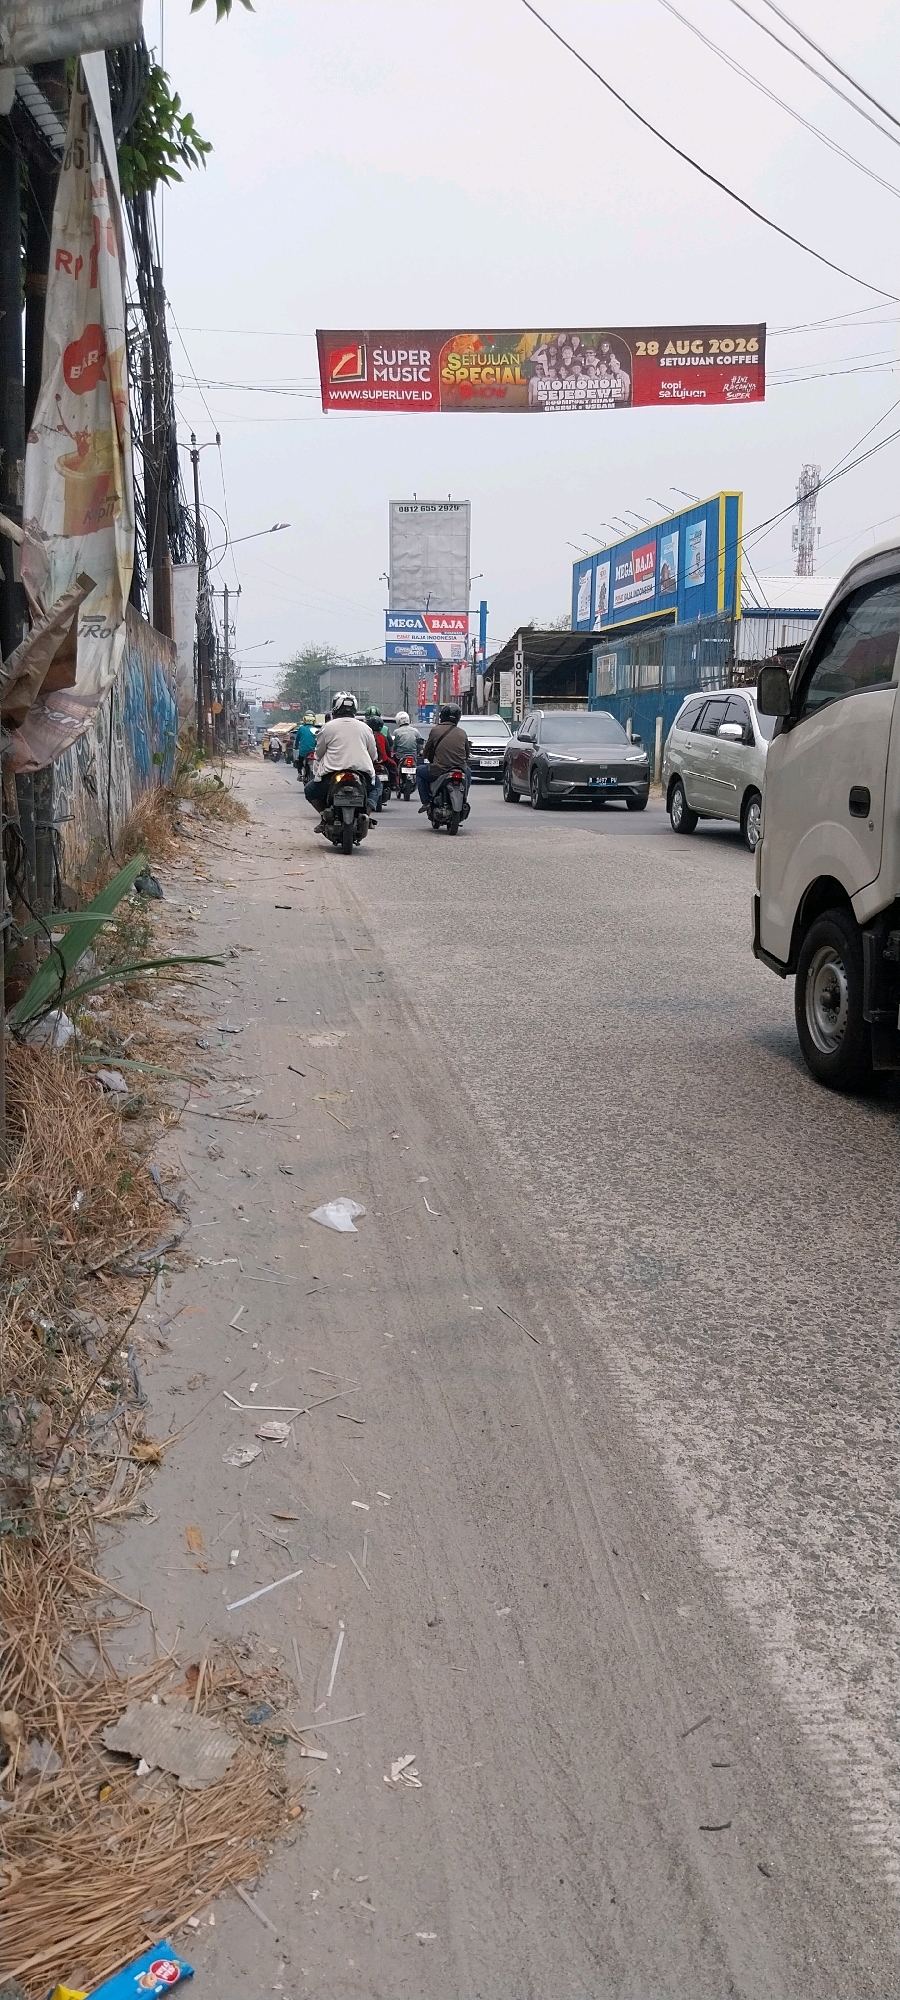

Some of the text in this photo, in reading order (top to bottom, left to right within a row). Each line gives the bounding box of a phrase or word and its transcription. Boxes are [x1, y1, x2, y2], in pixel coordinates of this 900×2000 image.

[635, 337, 759, 356] 28 AUG 2026
[372, 349, 431, 366] SUPER
[447, 352, 520, 371] SETUJUAN
[659, 354, 759, 367] SETUJUAN COFFEE
[373, 367, 431, 382] MUSIC
[441, 366, 527, 385] SPECIAL
[537, 379, 622, 391] MOMONON
[661, 380, 682, 390] kopi
[329, 390, 433, 401] WWW.SUPERLIVE.ID
[537, 388, 622, 401] SEJEDEWE
[398, 505, 419, 513] 0812
[615, 561, 633, 580] MEGA
[635, 552, 654, 573] BAJA
[388, 618, 464, 629] MEGA BAJA
